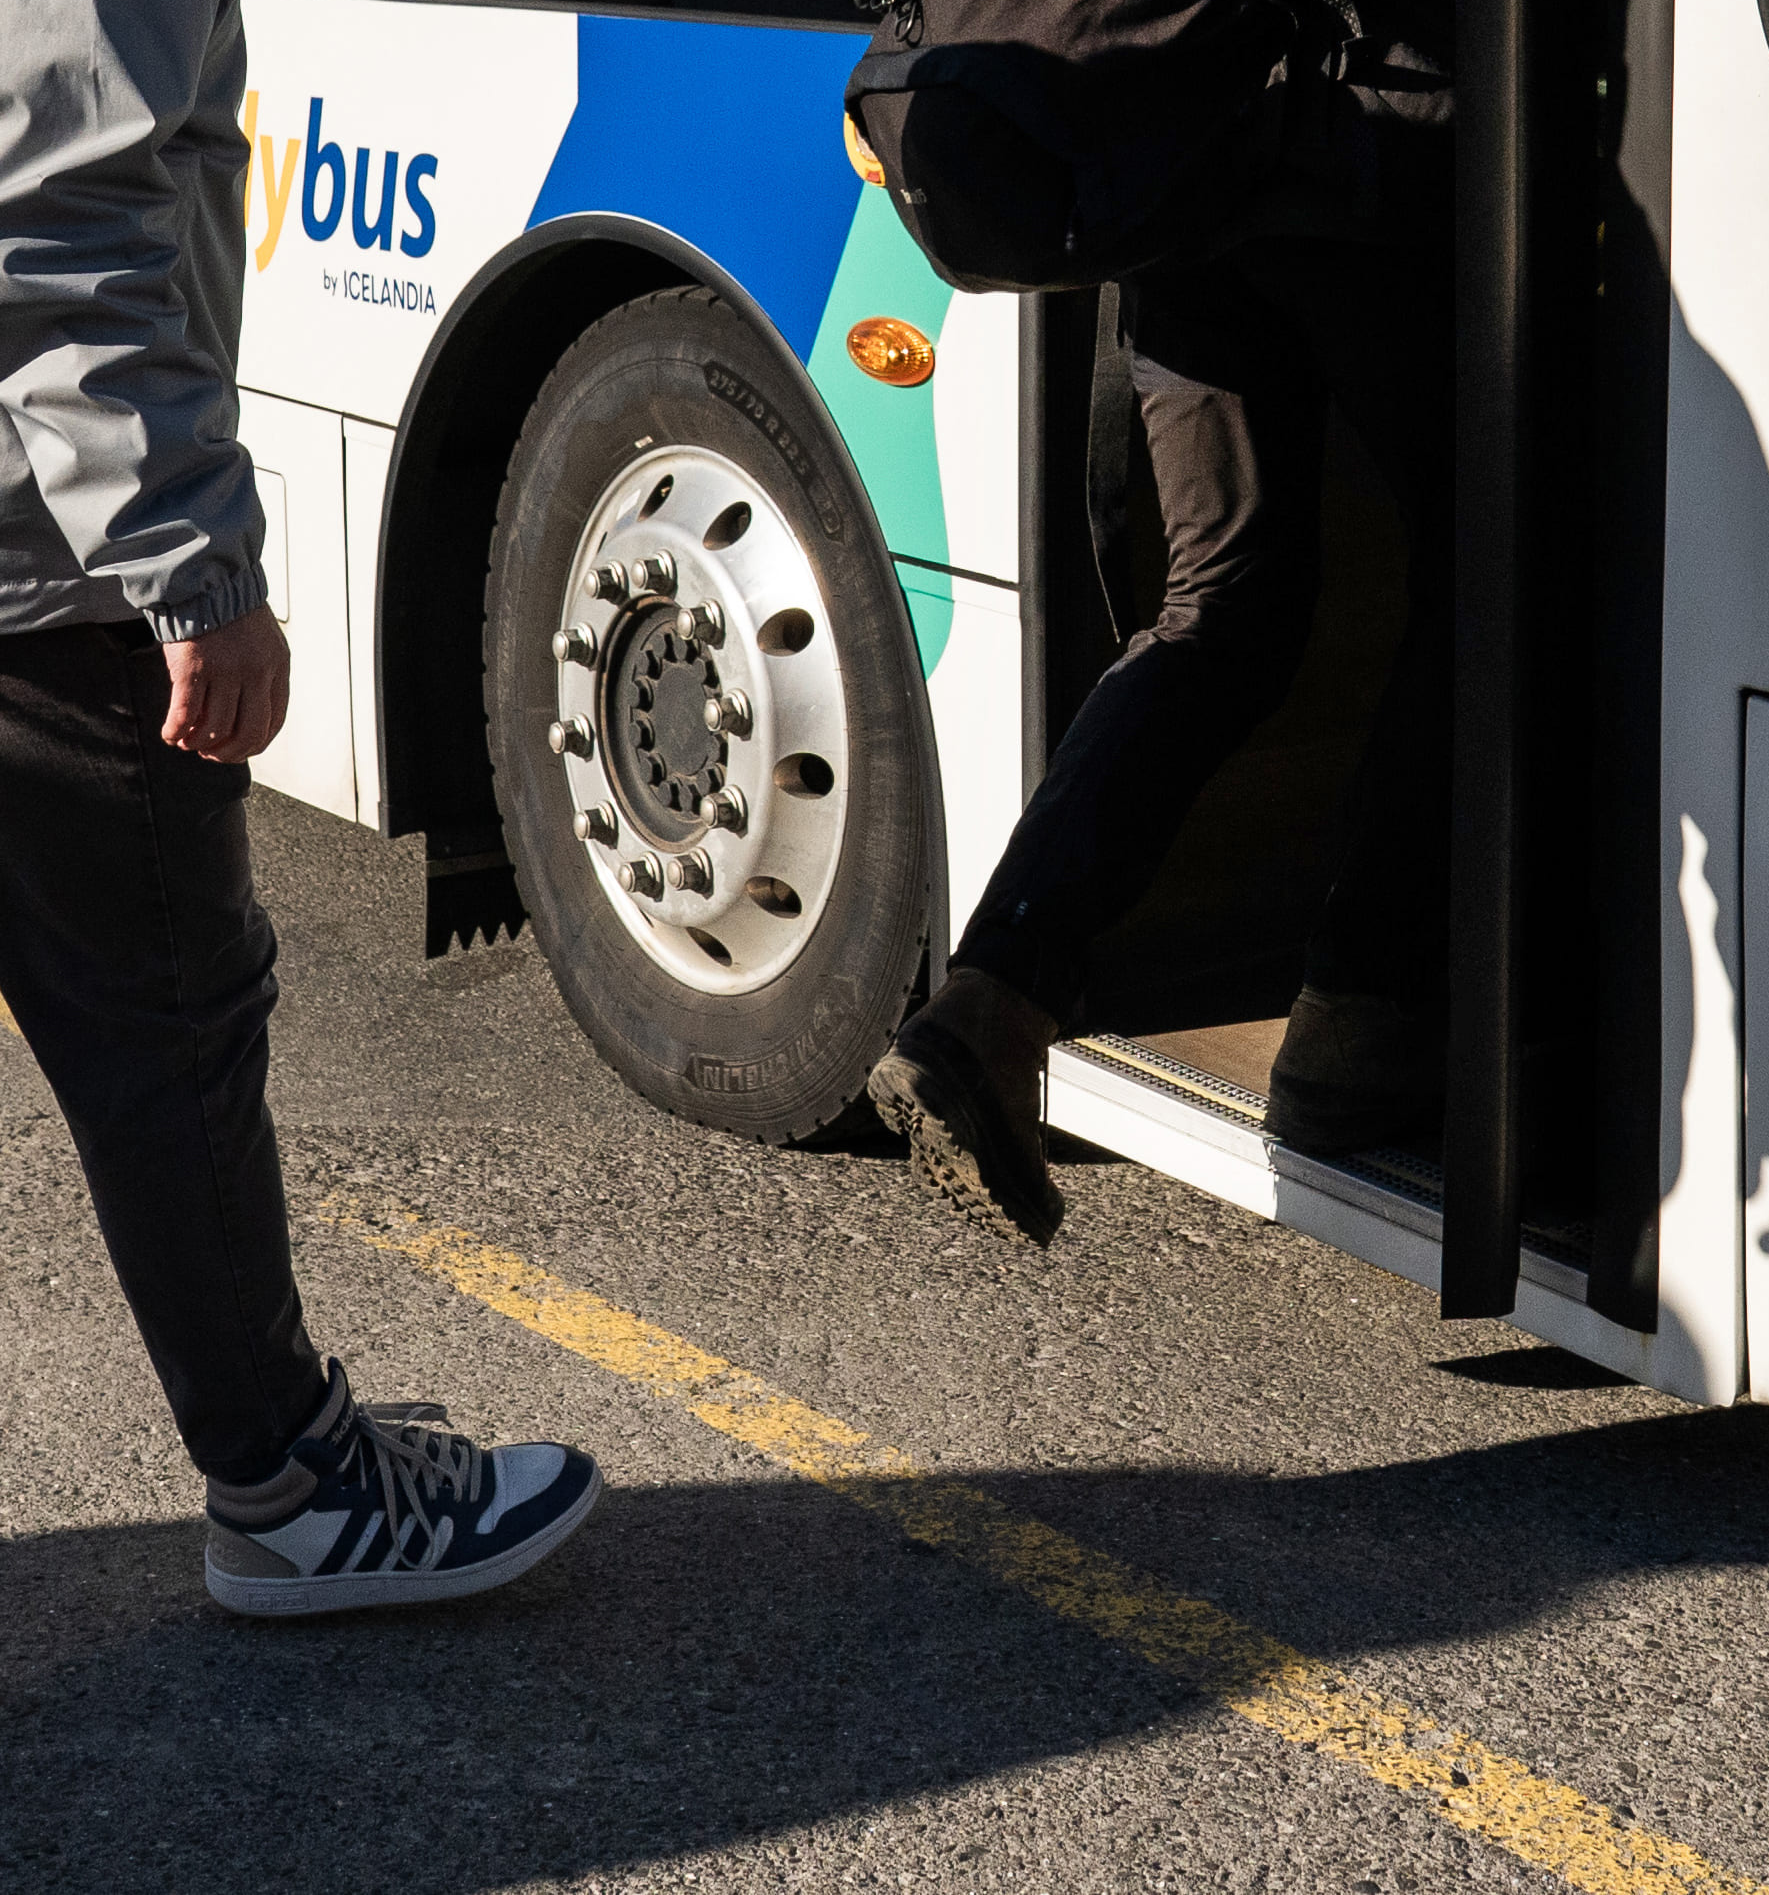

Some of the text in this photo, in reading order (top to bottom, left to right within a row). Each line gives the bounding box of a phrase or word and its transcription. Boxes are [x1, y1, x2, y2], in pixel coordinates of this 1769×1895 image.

[244, 90, 438, 273] lybus
[324, 268, 436, 316] by ICELANDIA
